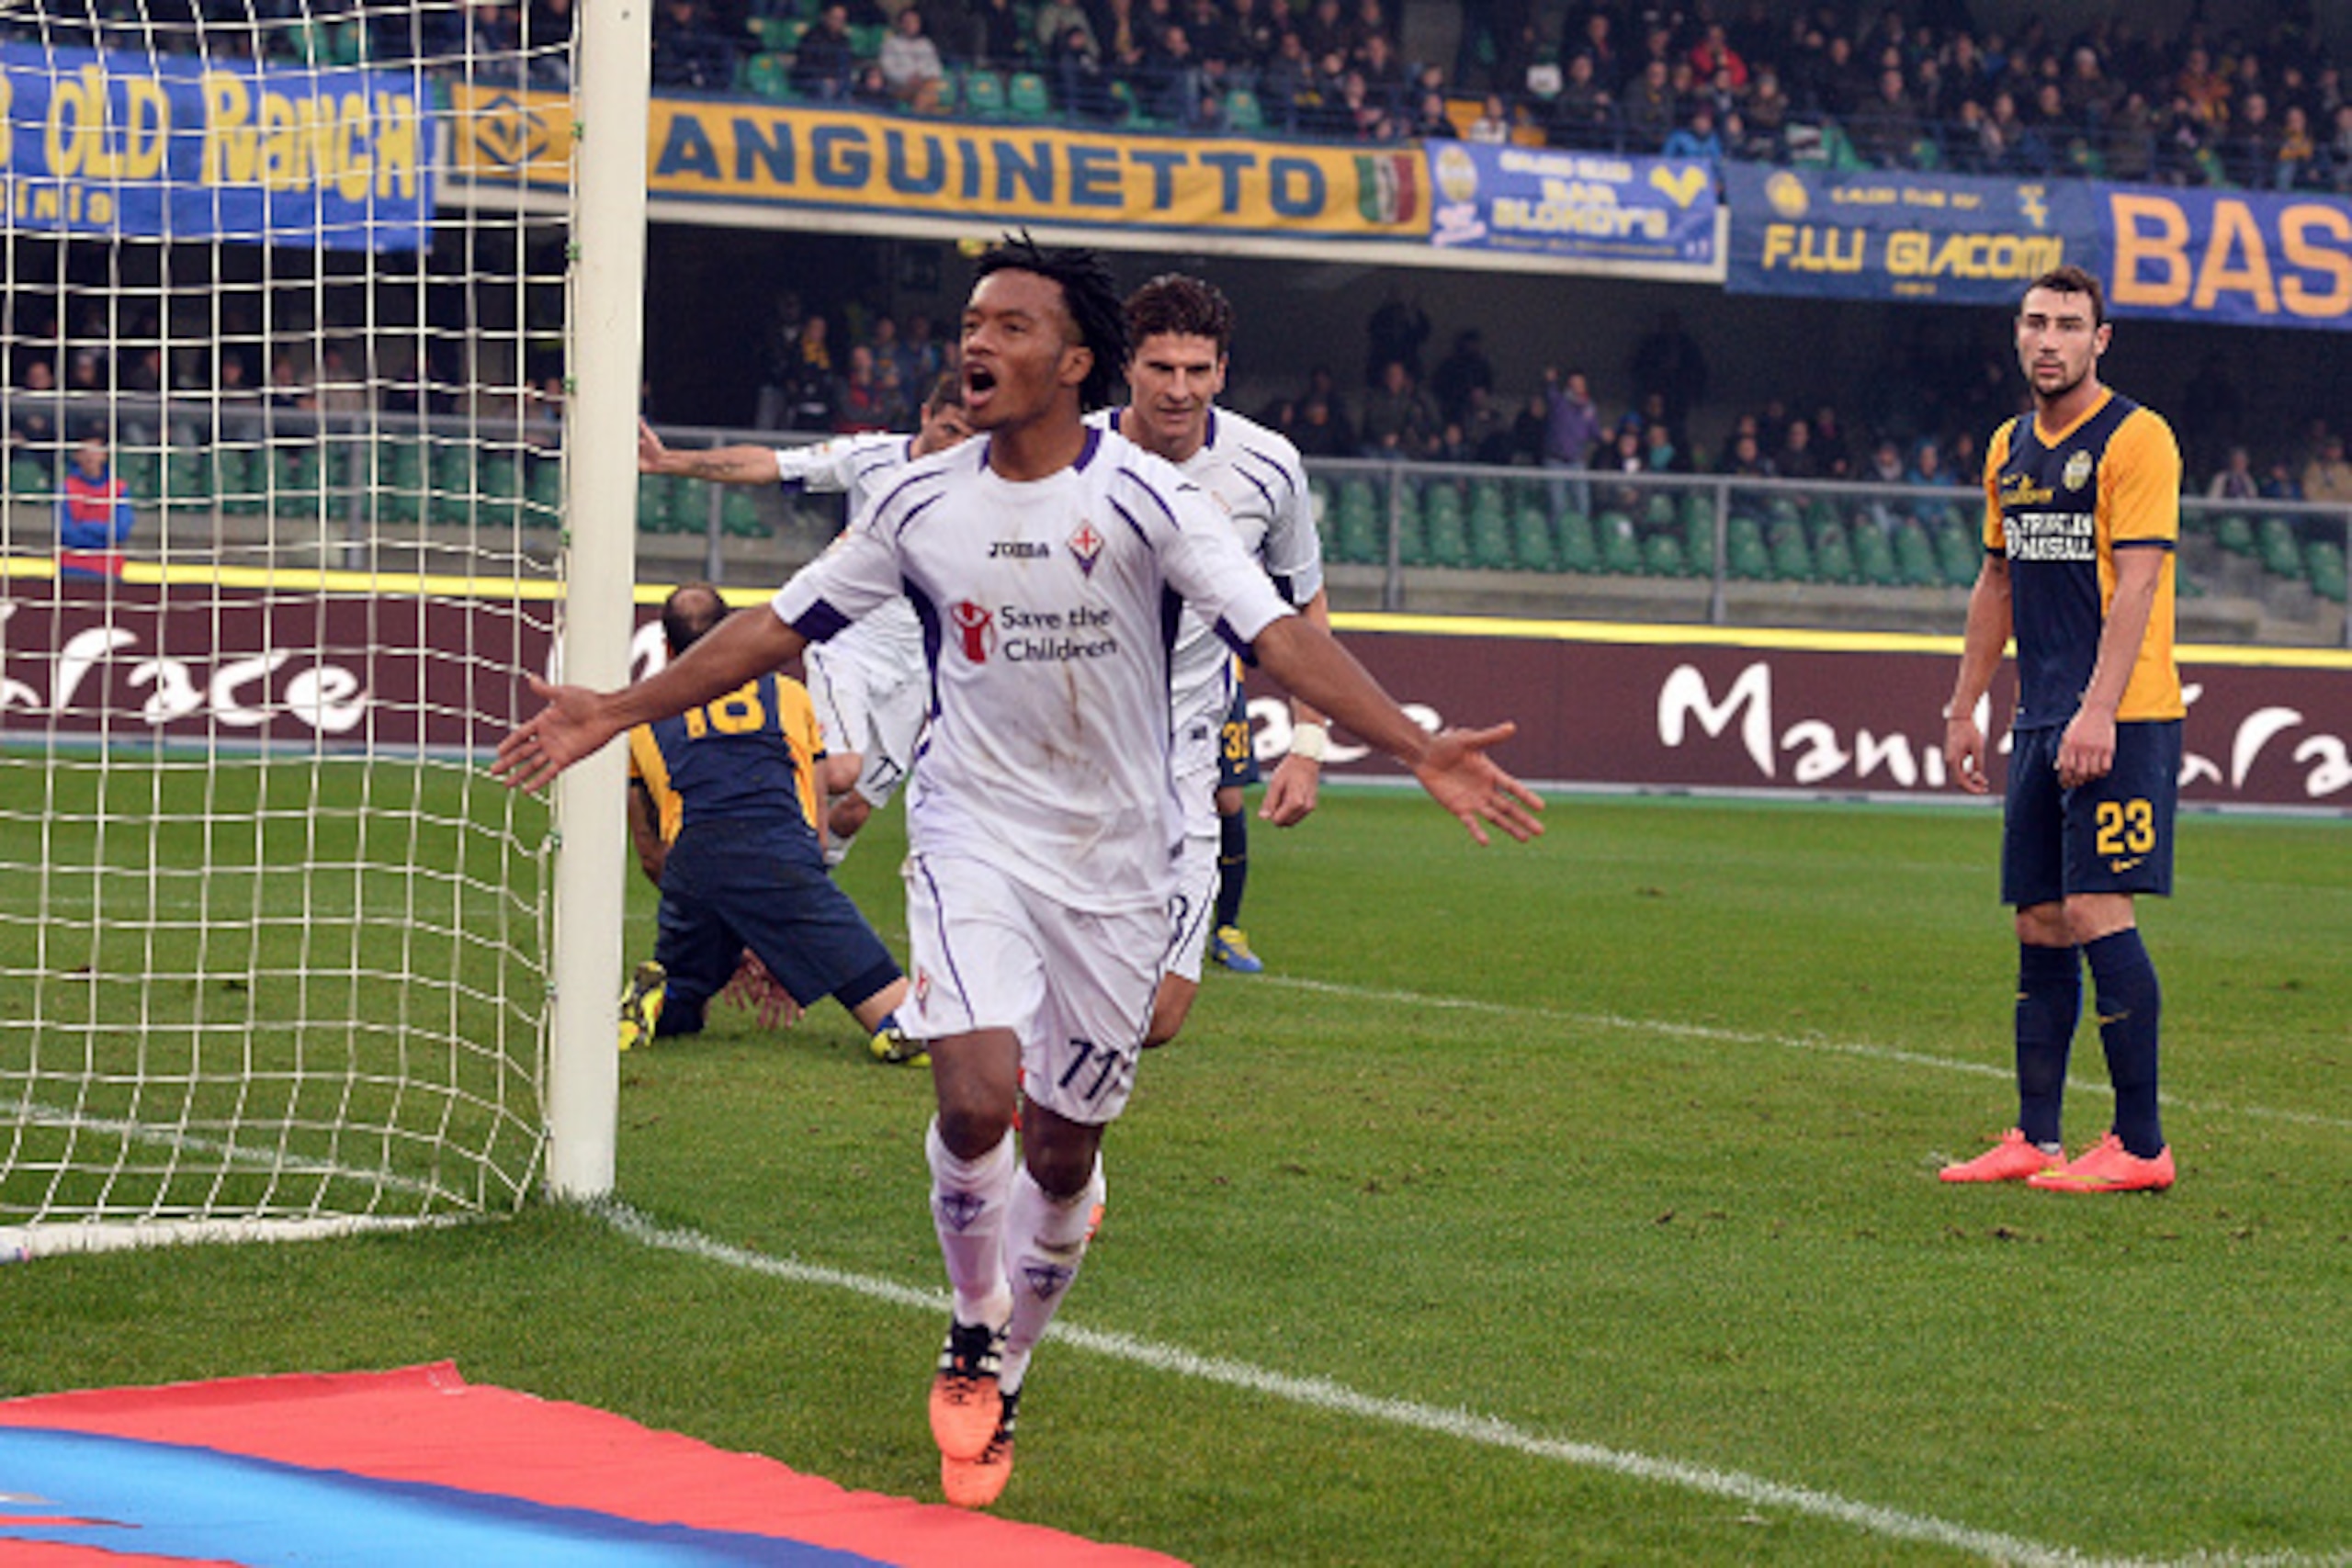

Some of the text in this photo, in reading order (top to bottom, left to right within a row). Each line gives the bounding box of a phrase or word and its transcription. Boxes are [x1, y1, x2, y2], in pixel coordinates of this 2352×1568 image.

[44, 63, 170, 179] OLD
[653, 112, 1326, 219] ANGUINETTO
[2110, 193, 2352, 318] BAS
[0, 604, 369, 732] race
[1001, 604, 1111, 628] Save the
[1004, 637, 1117, 662] Children
[2096, 797, 2156, 855] 23
